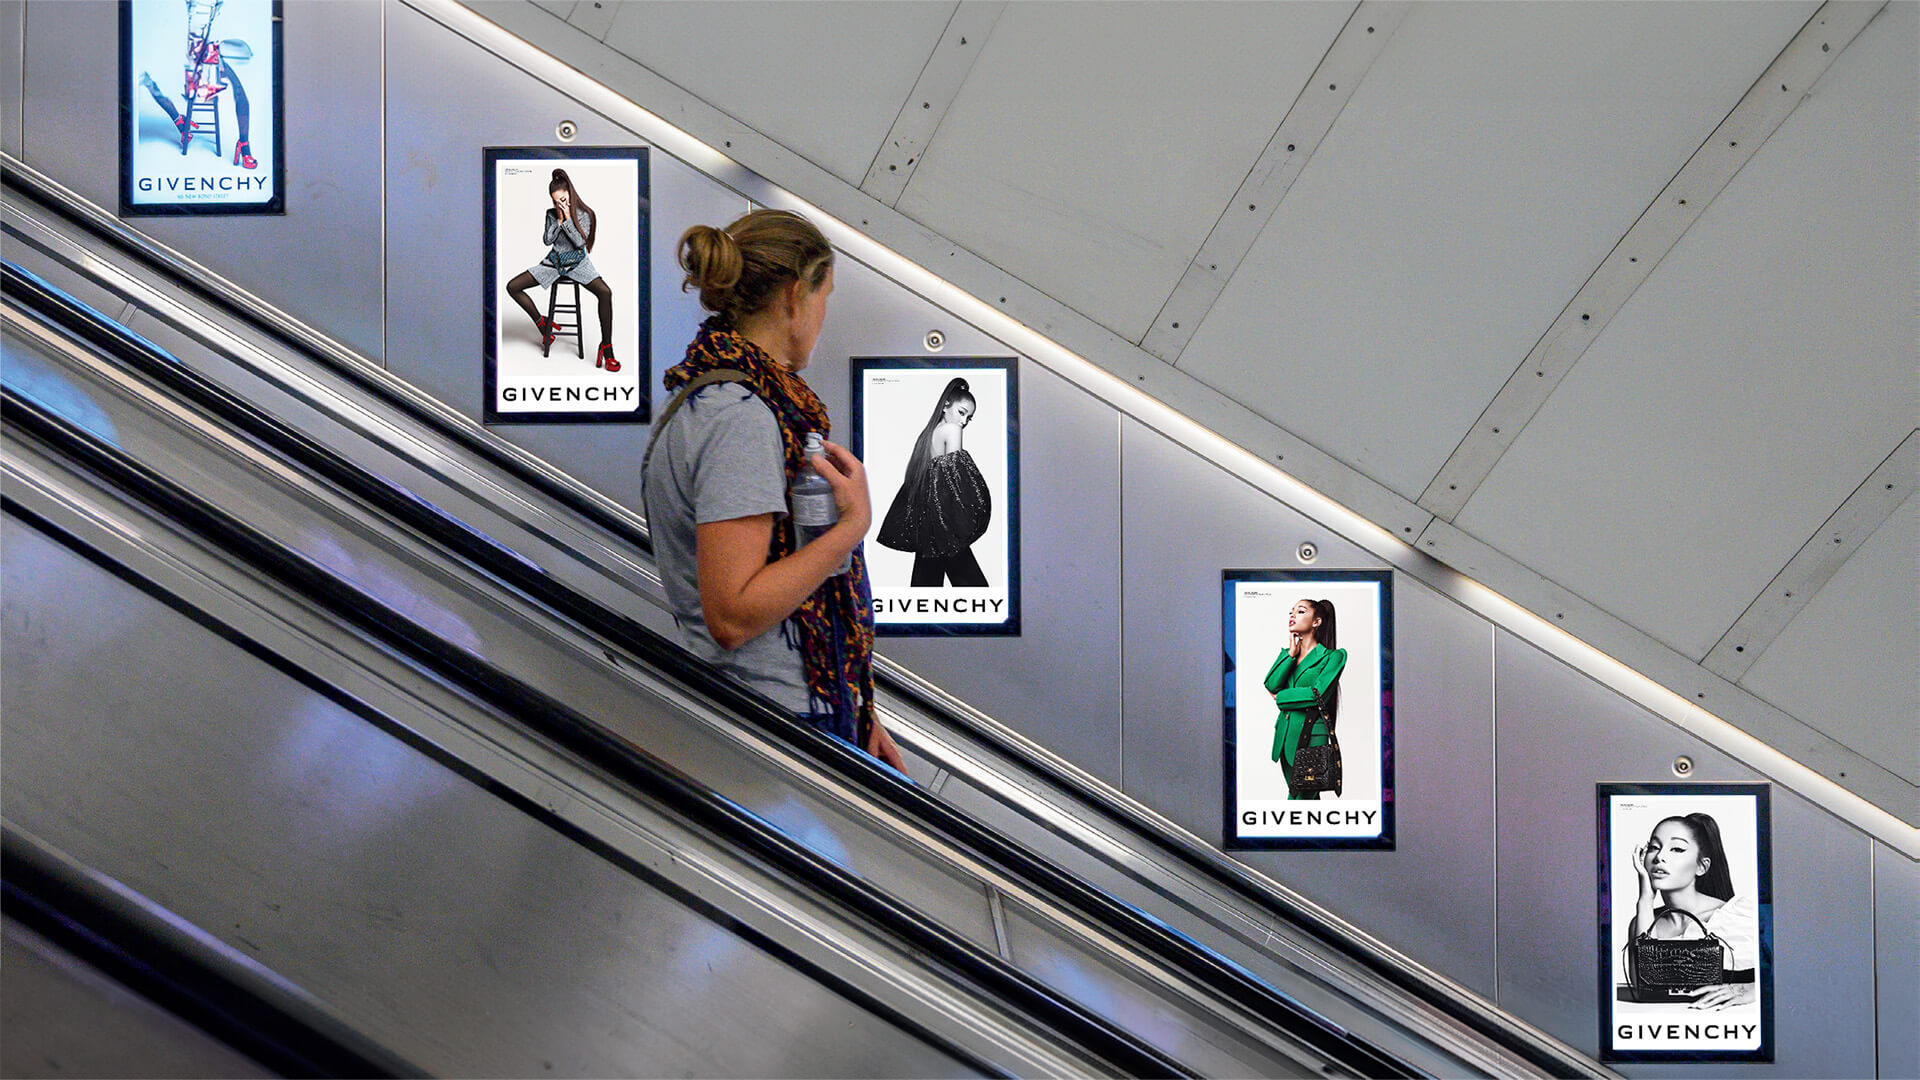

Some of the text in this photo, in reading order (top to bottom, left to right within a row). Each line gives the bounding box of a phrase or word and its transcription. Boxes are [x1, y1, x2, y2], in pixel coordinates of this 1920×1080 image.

[138, 176, 268, 191] GIVENCHY
[502, 386, 635, 402] GIVENCHY
[872, 598, 1004, 613] GIVENCHY
[1242, 810, 1377, 826] GIVENCHY
[1617, 1024, 1757, 1040] GIVENCHY
